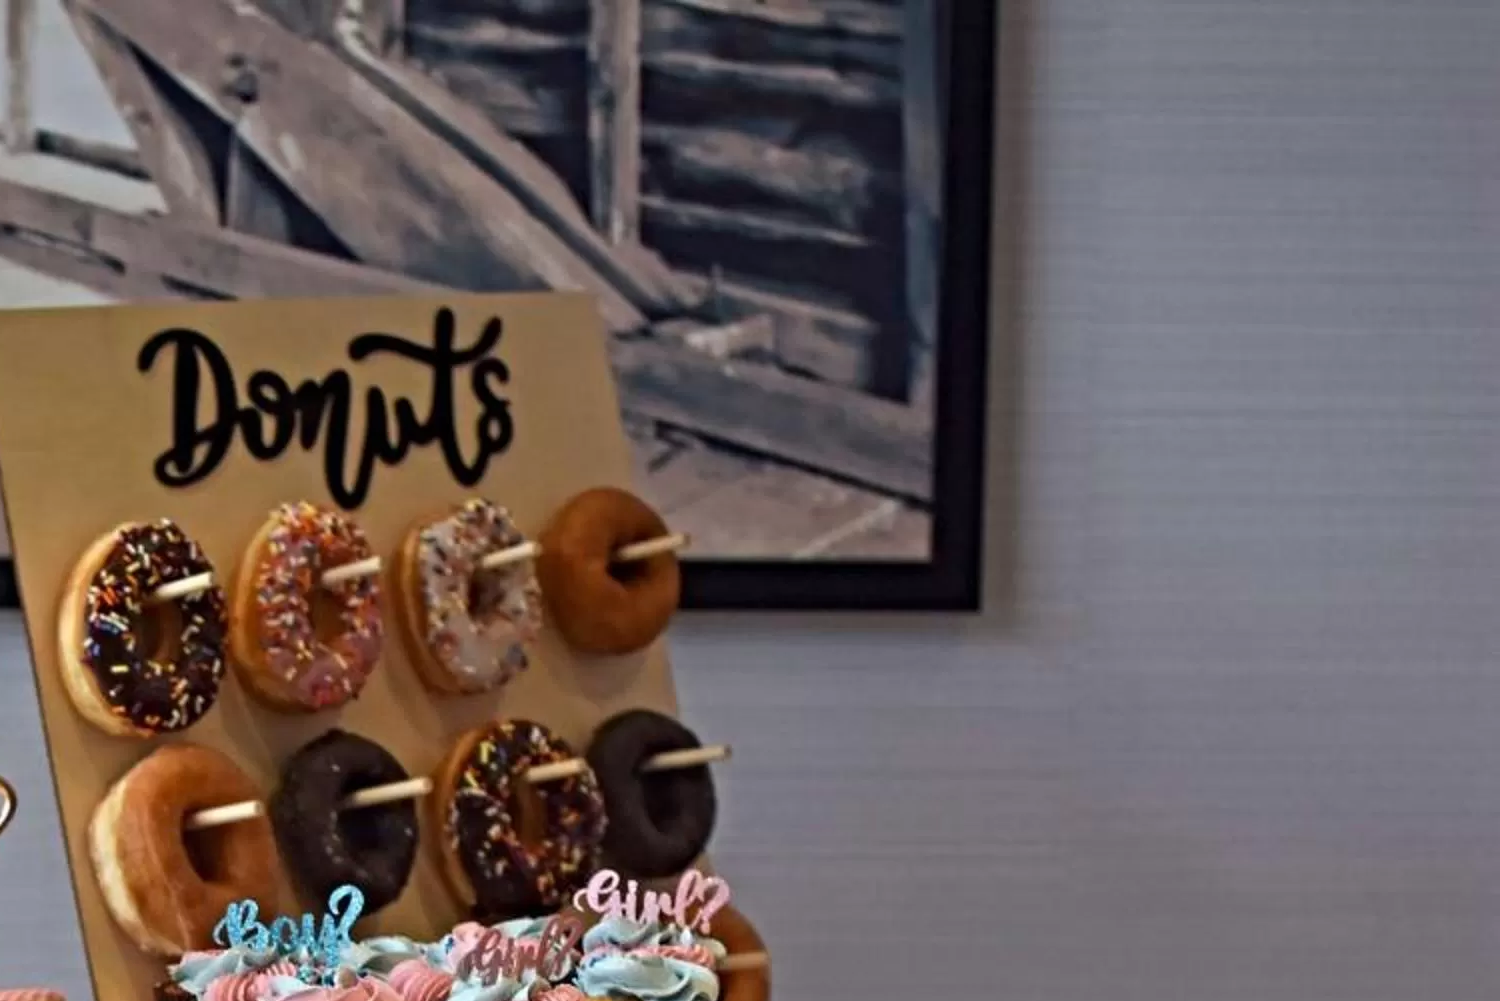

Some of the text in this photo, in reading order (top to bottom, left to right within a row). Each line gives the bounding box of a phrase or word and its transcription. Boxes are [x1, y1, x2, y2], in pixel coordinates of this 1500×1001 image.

[136, 306, 513, 510] Donuts
[213, 883, 365, 968] Boy?
[573, 868, 730, 935] Girl?
[457, 908, 584, 987] Girl?
